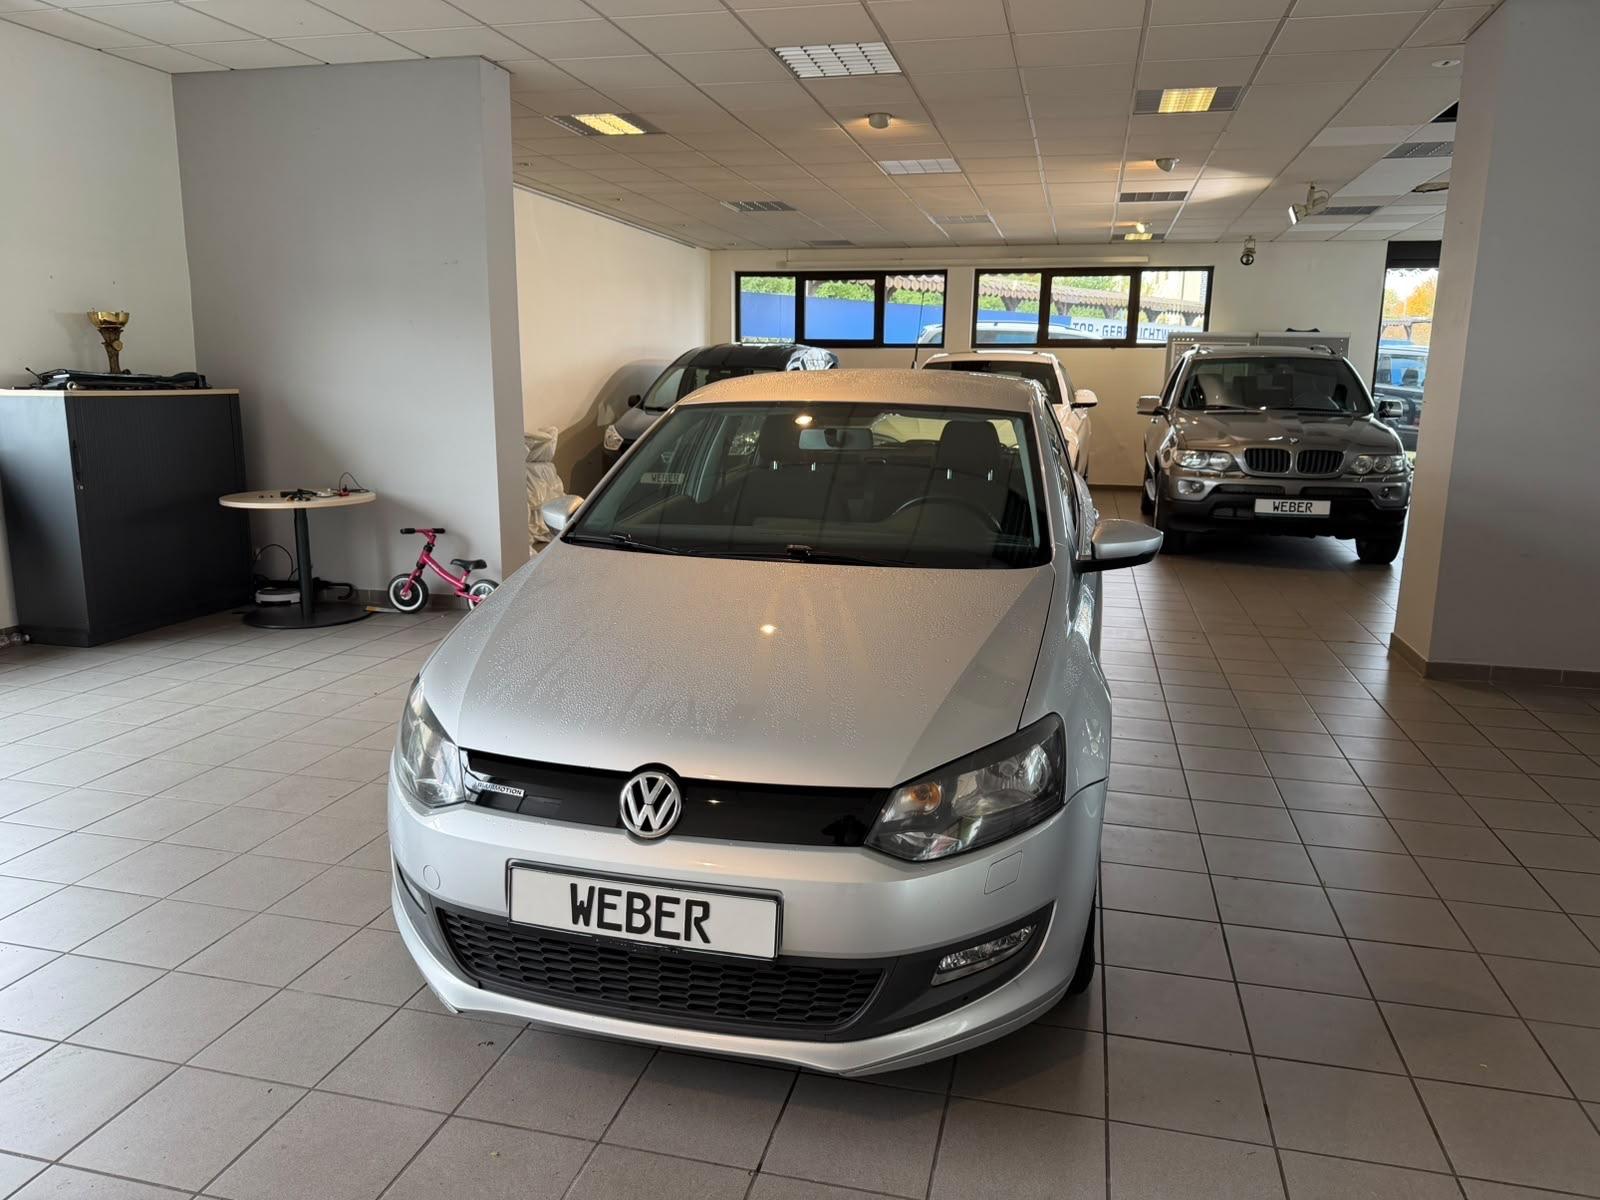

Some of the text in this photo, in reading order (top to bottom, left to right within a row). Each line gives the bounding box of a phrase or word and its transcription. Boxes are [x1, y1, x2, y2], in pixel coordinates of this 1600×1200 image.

[1273, 501, 1313, 513] WEBER
[620, 771, 682, 838] VW
[570, 883, 711, 944] WEBER
